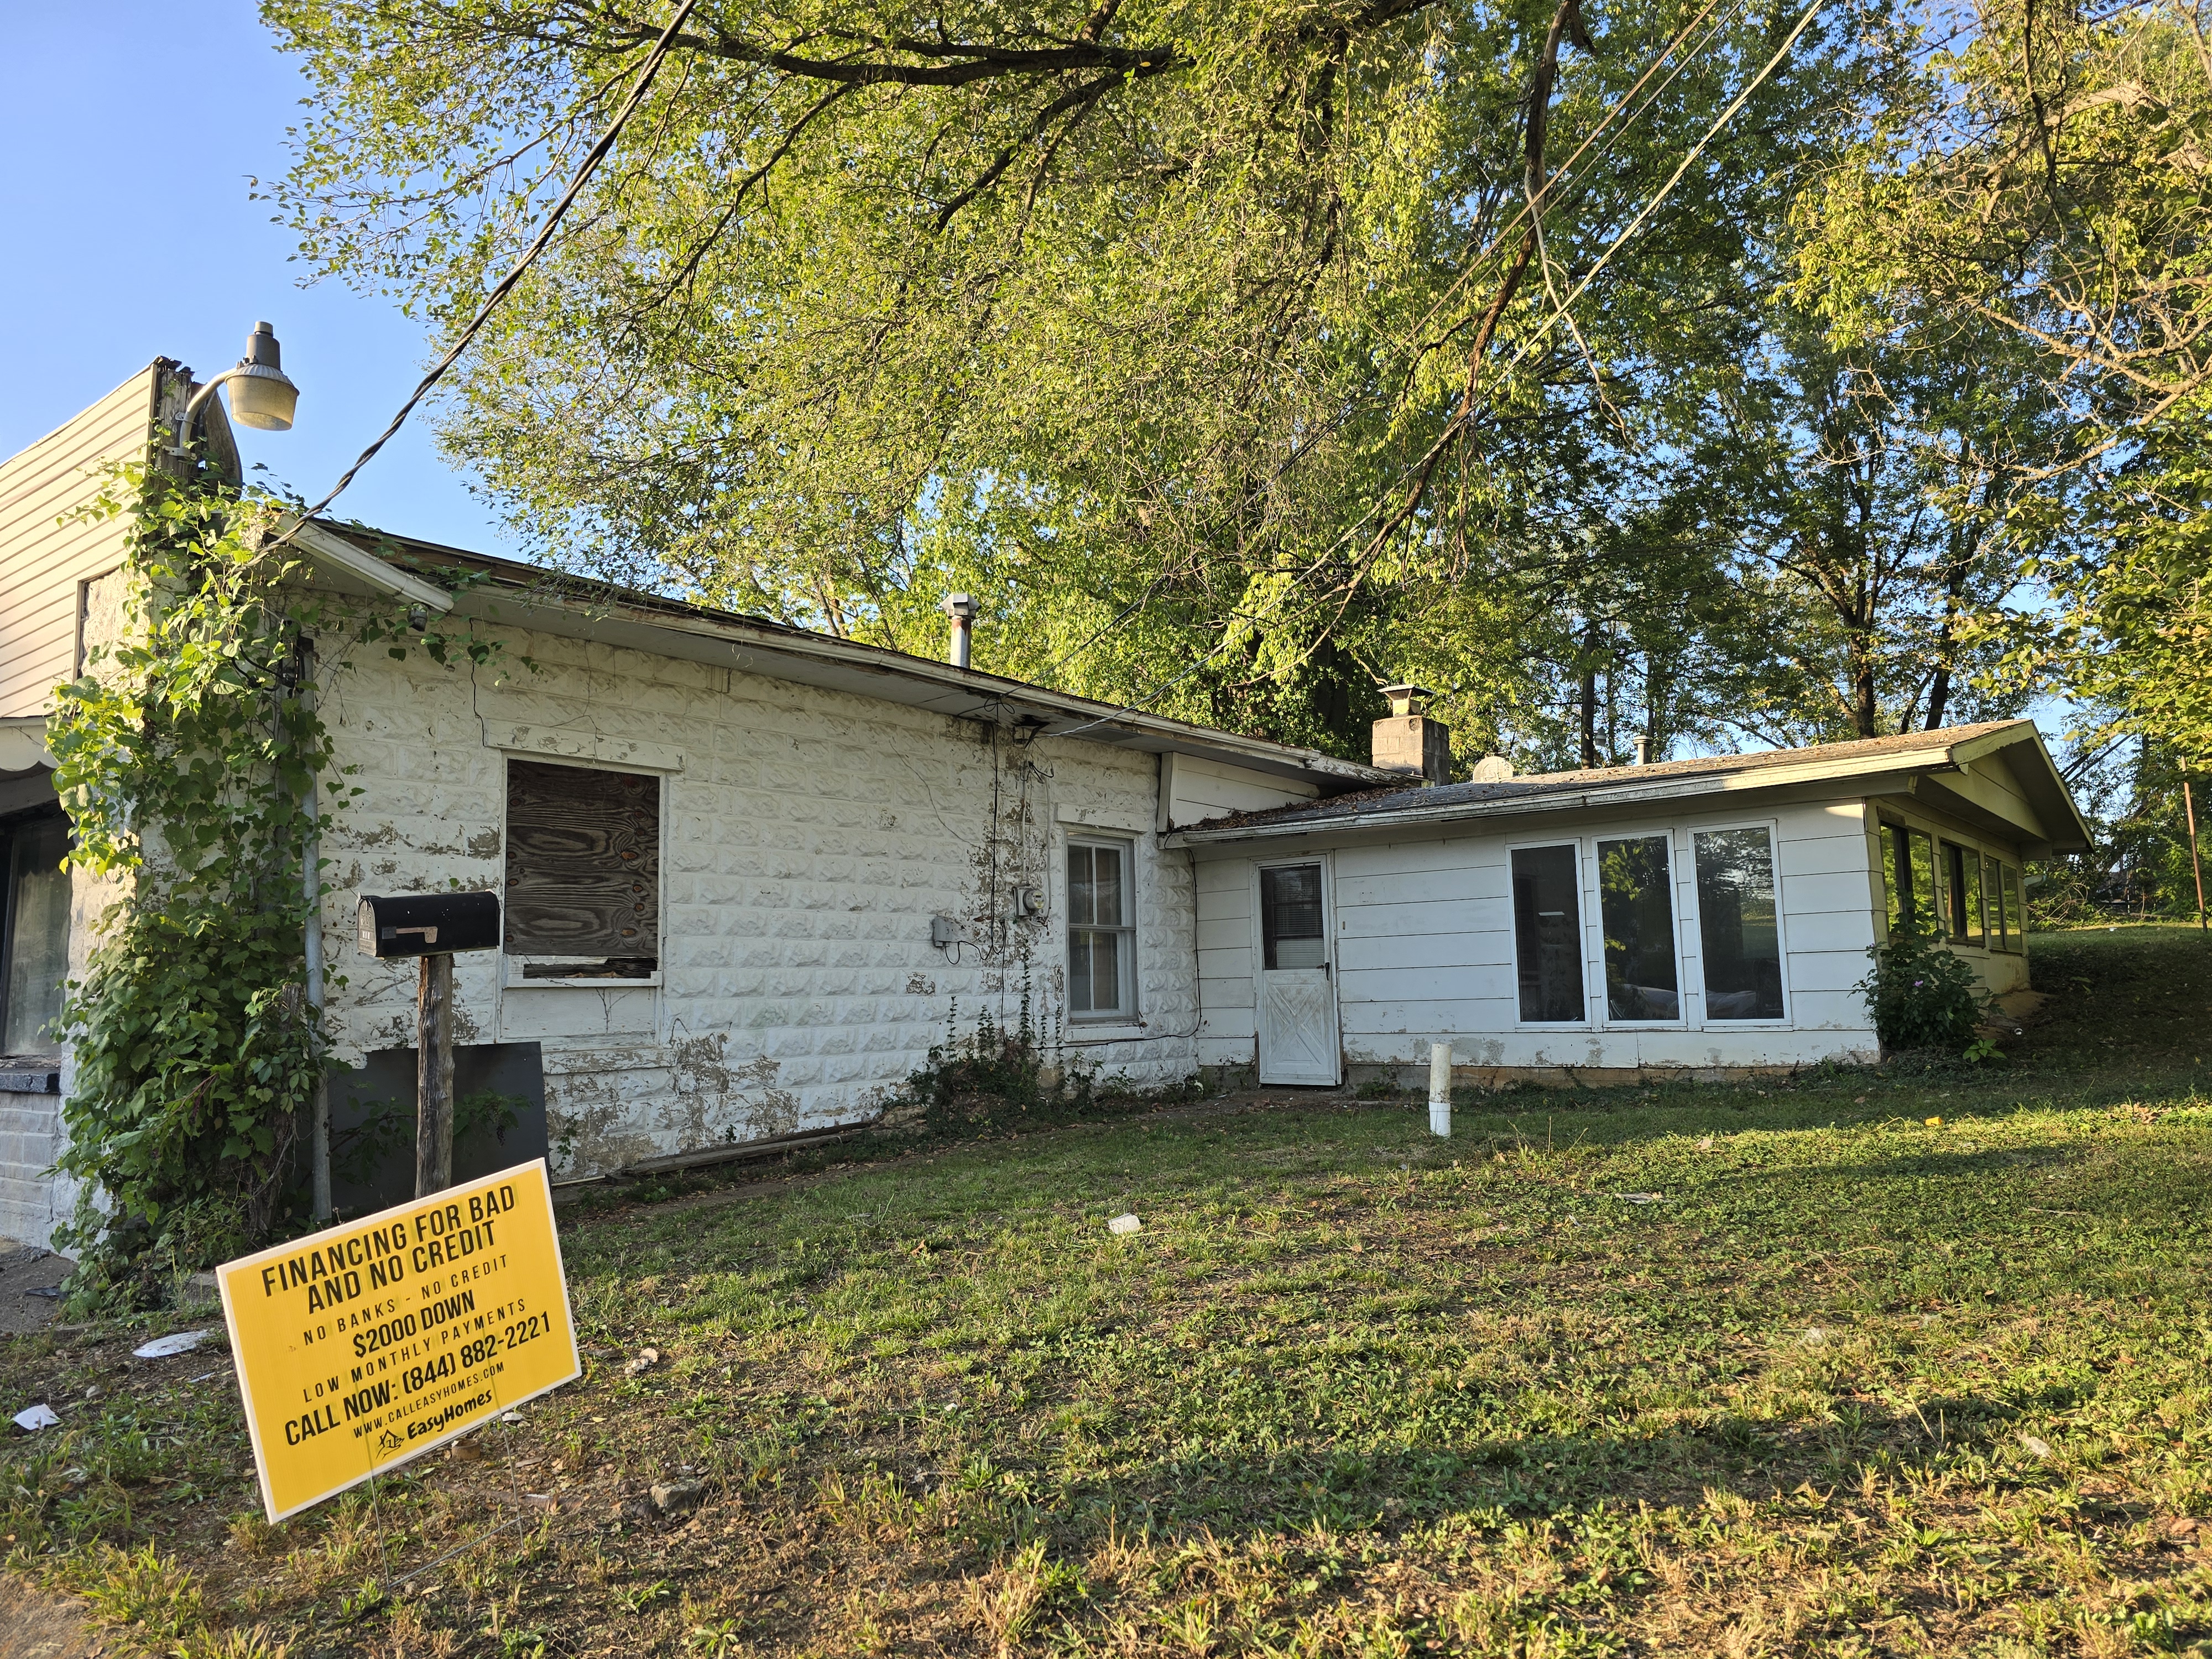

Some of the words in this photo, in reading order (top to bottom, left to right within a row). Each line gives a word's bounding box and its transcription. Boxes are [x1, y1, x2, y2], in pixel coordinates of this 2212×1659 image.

[262, 1223, 407, 1297] FINANCING
[415, 1204, 462, 1243] FOR
[468, 1185, 514, 1223] BAD
[308, 1271, 361, 1314] AND
[369, 1255, 404, 1290] NO
[412, 1219, 494, 1273] CREDIT
[303, 1326, 326, 1346] NO
[337, 1299, 395, 1333] BANKS
[421, 1281, 441, 1300] NO
[451, 1254, 506, 1287] CREDIT
[353, 1314, 417, 1359] $2000
[420, 1289, 475, 1331] DOWN
[285, 1404, 341, 1446] CALL
[343, 1379, 398, 1421] NOW:
[402, 1352, 456, 1394] (844)
[460, 1311, 550, 1368] 882-2221
[303, 1375, 339, 1403] LOW
[351, 1337, 430, 1383] MONTHLY
[441, 1298, 525, 1345] PAYMENTS
[353, 1361, 504, 1438] WWW.CALLEASYHOMES.COM
[407, 1389, 492, 1440] EasyHomes
